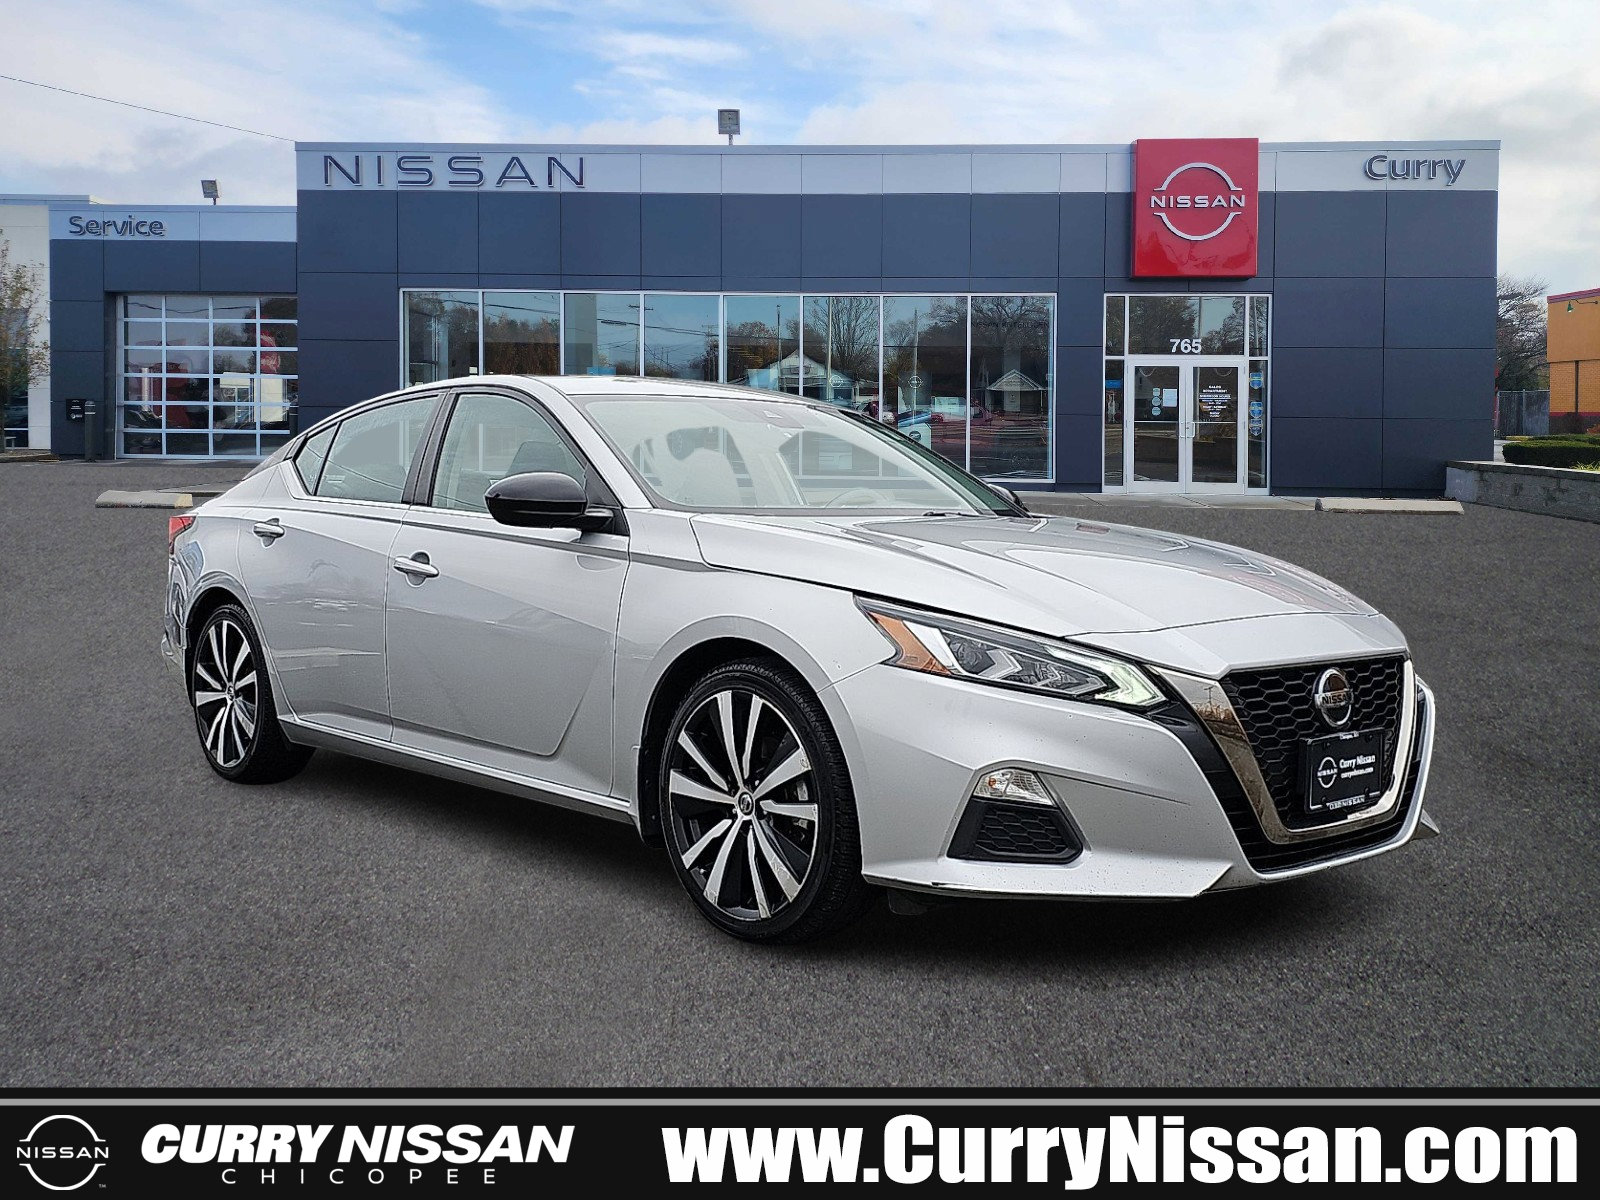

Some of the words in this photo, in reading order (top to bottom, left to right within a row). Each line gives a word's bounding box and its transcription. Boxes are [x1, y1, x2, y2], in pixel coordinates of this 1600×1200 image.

[324, 155, 585, 188] NISSAN
[1364, 154, 1467, 186] Curry
[1150, 195, 1246, 208] NISSAN
[68, 215, 166, 236] Service
[1169, 338, 1202, 354] 765
[1339, 759, 1357, 769] Curry
[1356, 755, 1376, 765] Nissan
[1317, 768, 1338, 777] NISSAN
